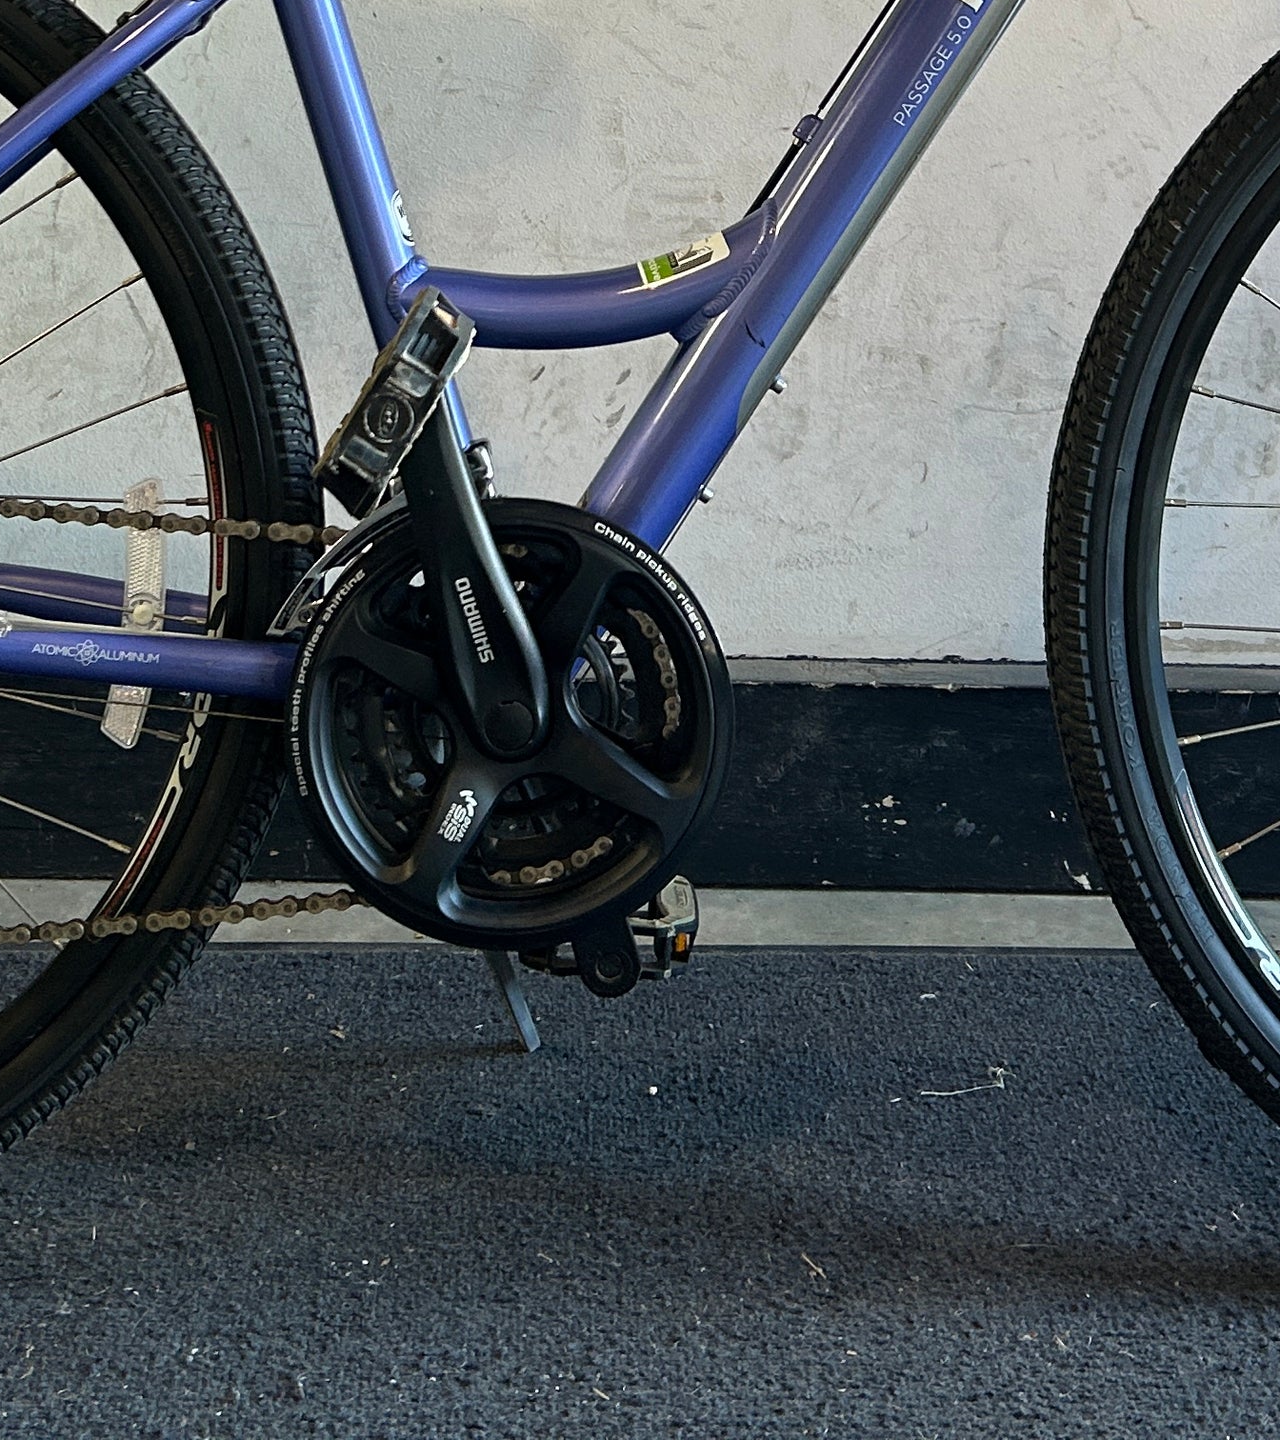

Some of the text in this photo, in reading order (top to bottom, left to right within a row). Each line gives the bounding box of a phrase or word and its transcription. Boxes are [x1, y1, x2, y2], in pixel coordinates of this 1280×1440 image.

[893, 14, 972, 127] PASSAGE 5.0
[594, 522, 706, 641] Chain pickup ridges
[455, 577, 495, 663] SHIMANO
[32, 643, 160, 664] ATOMIC ALUMINUM
[437, 803, 457, 834] INDEX
[454, 815, 471, 842] DUAL
